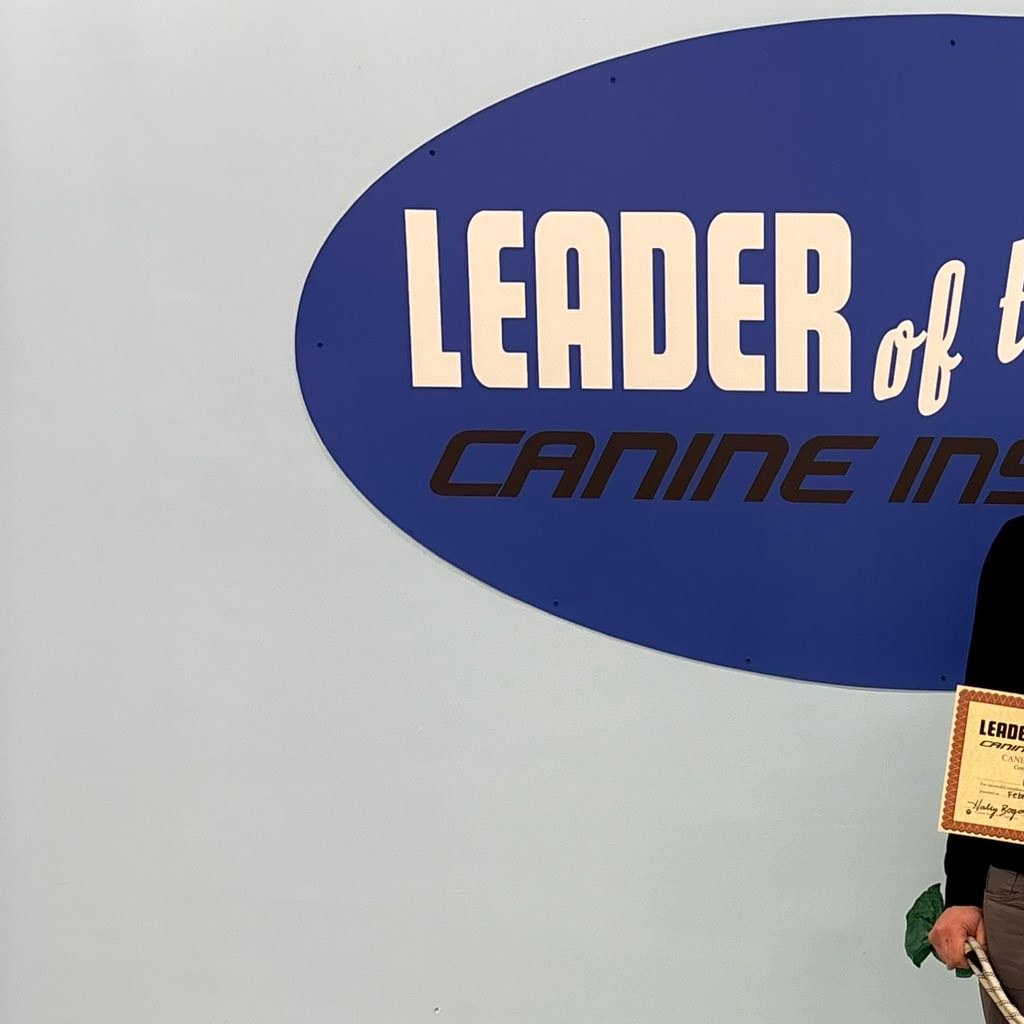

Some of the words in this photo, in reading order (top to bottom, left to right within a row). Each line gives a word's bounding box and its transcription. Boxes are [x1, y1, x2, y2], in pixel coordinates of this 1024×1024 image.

[404, 208, 852, 393] LEADER
[873, 259, 966, 416] of
[429, 429, 880, 504] CANINE
